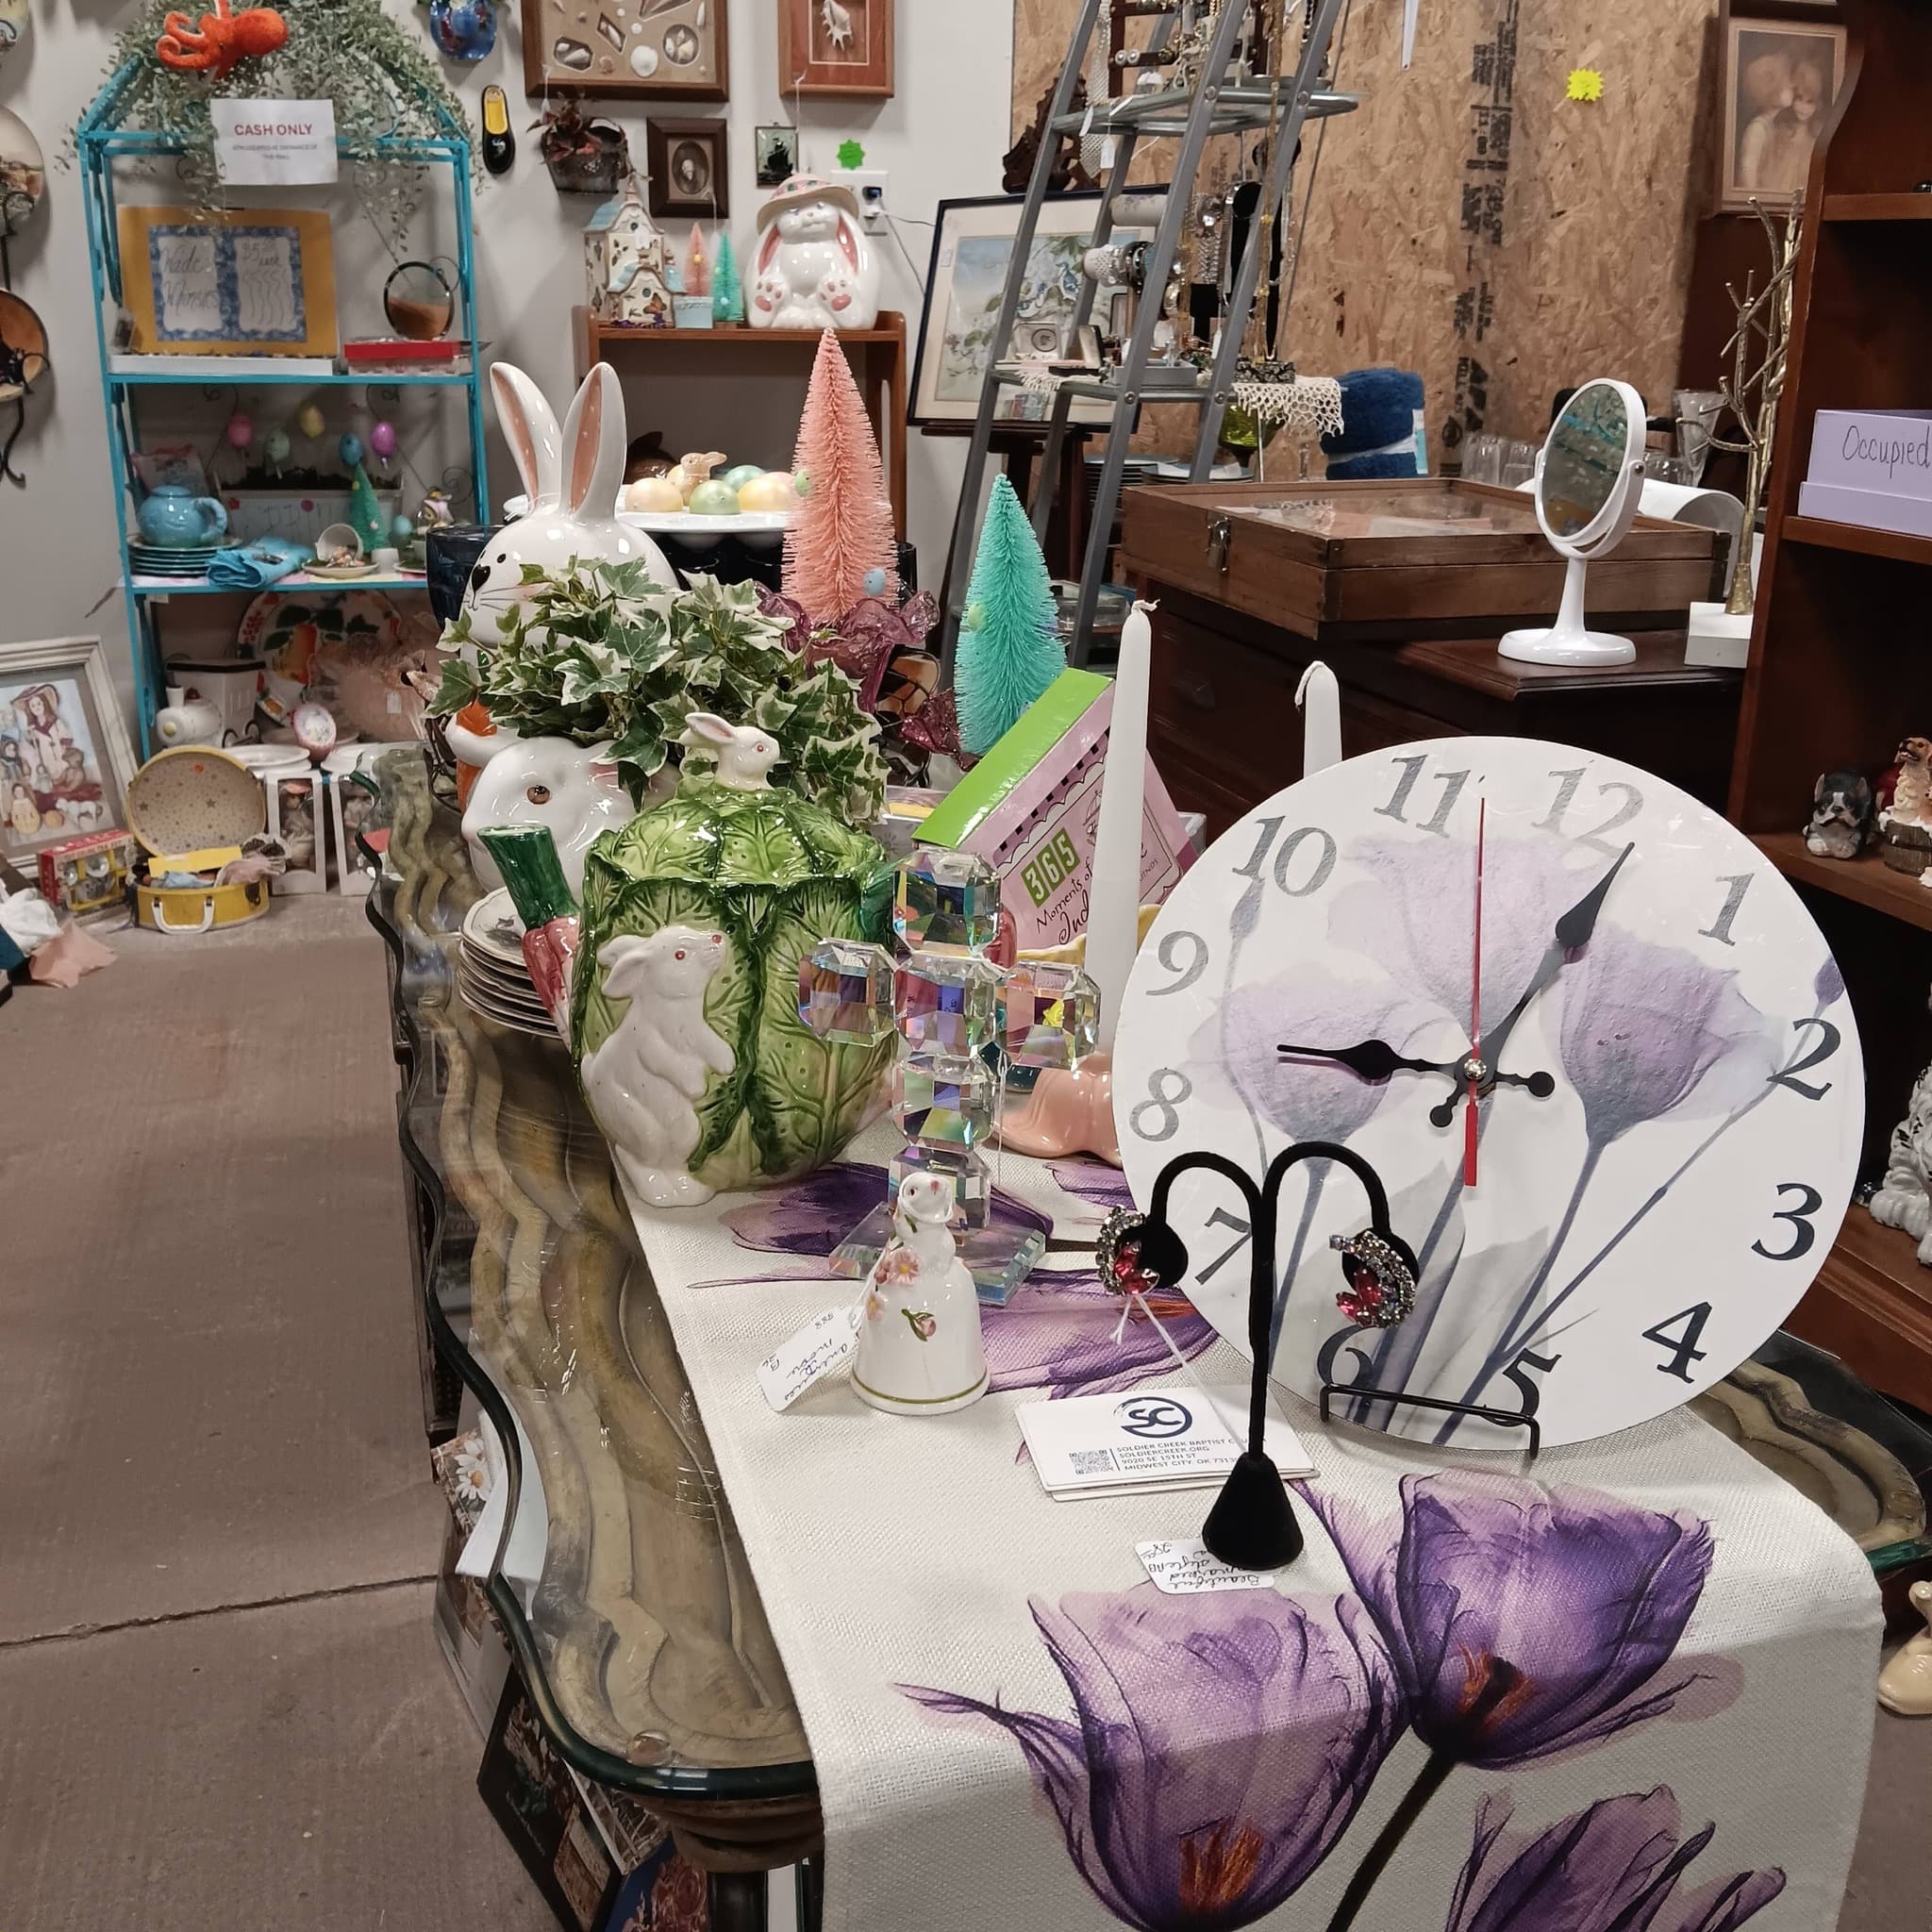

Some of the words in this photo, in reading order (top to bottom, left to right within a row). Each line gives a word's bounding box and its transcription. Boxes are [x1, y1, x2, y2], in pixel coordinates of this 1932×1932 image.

[234, 124, 274, 136] CASH
[276, 124, 313, 136] ONLY
[1841, 425, 1931, 479] Occupied
[1374, 755, 1472, 839] 11
[1530, 767, 1644, 859] 12
[1024, 834, 1075, 900] 365
[1232, 815, 1337, 897] 10
[1037, 877, 1083, 934] Moments
[1698, 873, 1755, 946] 1
[1145, 930, 1209, 996] 9
[1766, 1017, 1841, 1101] 2
[1129, 1067, 1192, 1142] 8
[1194, 1208, 1255, 1285] 7
[1751, 1183, 1823, 1261] 3
[1317, 1324, 1382, 1393] 6
[1641, 1302, 1713, 1384] 4
[1127, 1407, 1183, 1428] SC
[1478, 1347, 1562, 1427] 5
[1117, 1443, 1156, 1453] SOLDIER
[1157, 1441, 1188, 1450] CREEK
[1189, 1438, 1225, 1446] BAPTIST
[1121, 1457, 1145, 1465] 9020
[1124, 1462, 1169, 1472] MIDWEST
[1169, 1574, 1260, 1590] Beautiful
